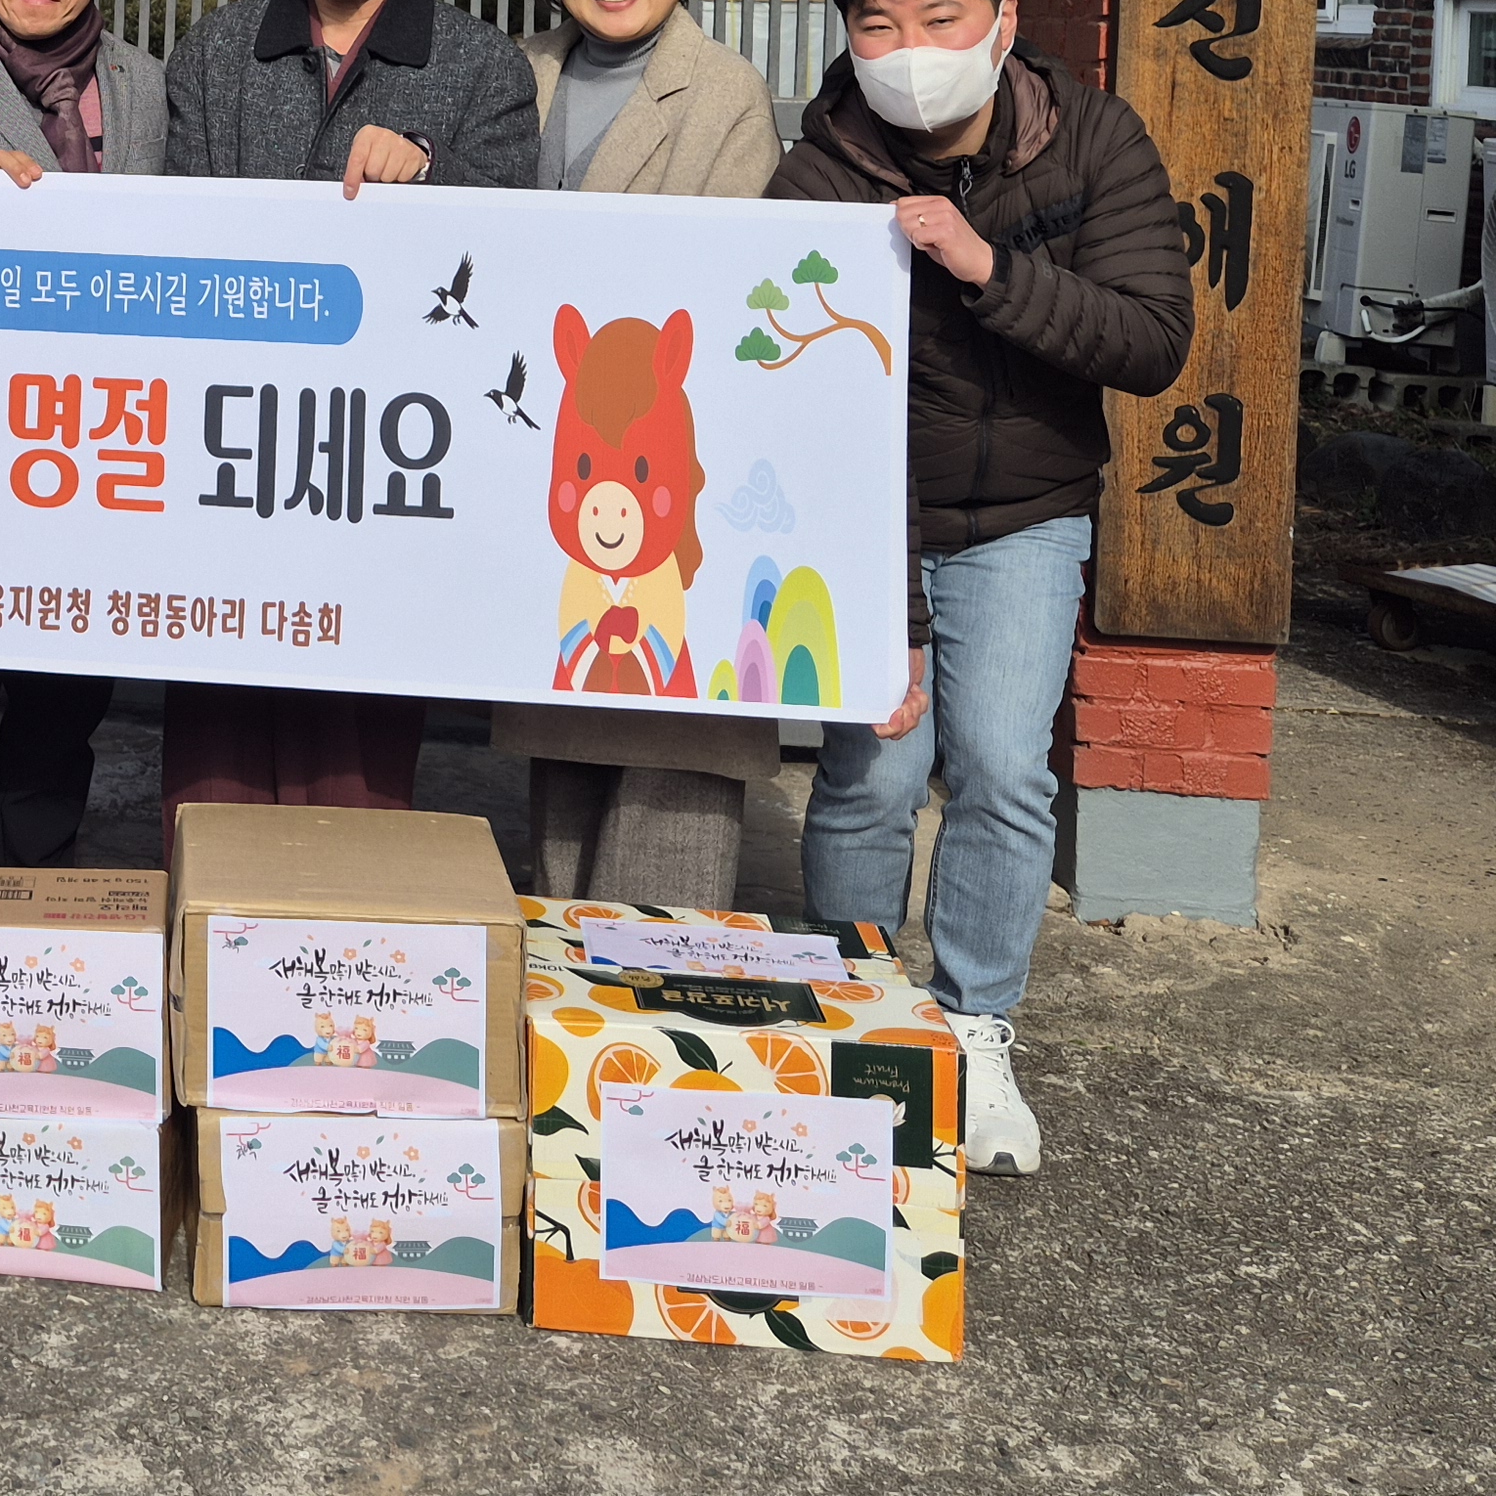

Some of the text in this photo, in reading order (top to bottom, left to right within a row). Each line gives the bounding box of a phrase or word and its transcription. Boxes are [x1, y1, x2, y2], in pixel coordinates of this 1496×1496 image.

[1344, 159, 1356, 179] LG
[0, 265, 22, 308] 일
[31, 270, 81, 312] 모두
[90, 269, 188, 316] 이루시길
[198, 274, 329, 322] 기원합니다.
[7, 373, 169, 513] 명절
[198, 383, 455, 524] 되세요
[106, 589, 246, 640] 청렴동아리
[260, 600, 342, 647] 다솜회
[659, 987, 792, 1015] 서귀포감귤
[18, 1052, 31, 1065] 福
[337, 1046, 350, 1059] 福
[864, 1064, 900, 1079] Fruit
[852, 1076, 911, 1094] Premium
[18, 1228, 30, 1241] 福
[735, 1221, 749, 1235] 福
[353, 1248, 366, 1260] 福
